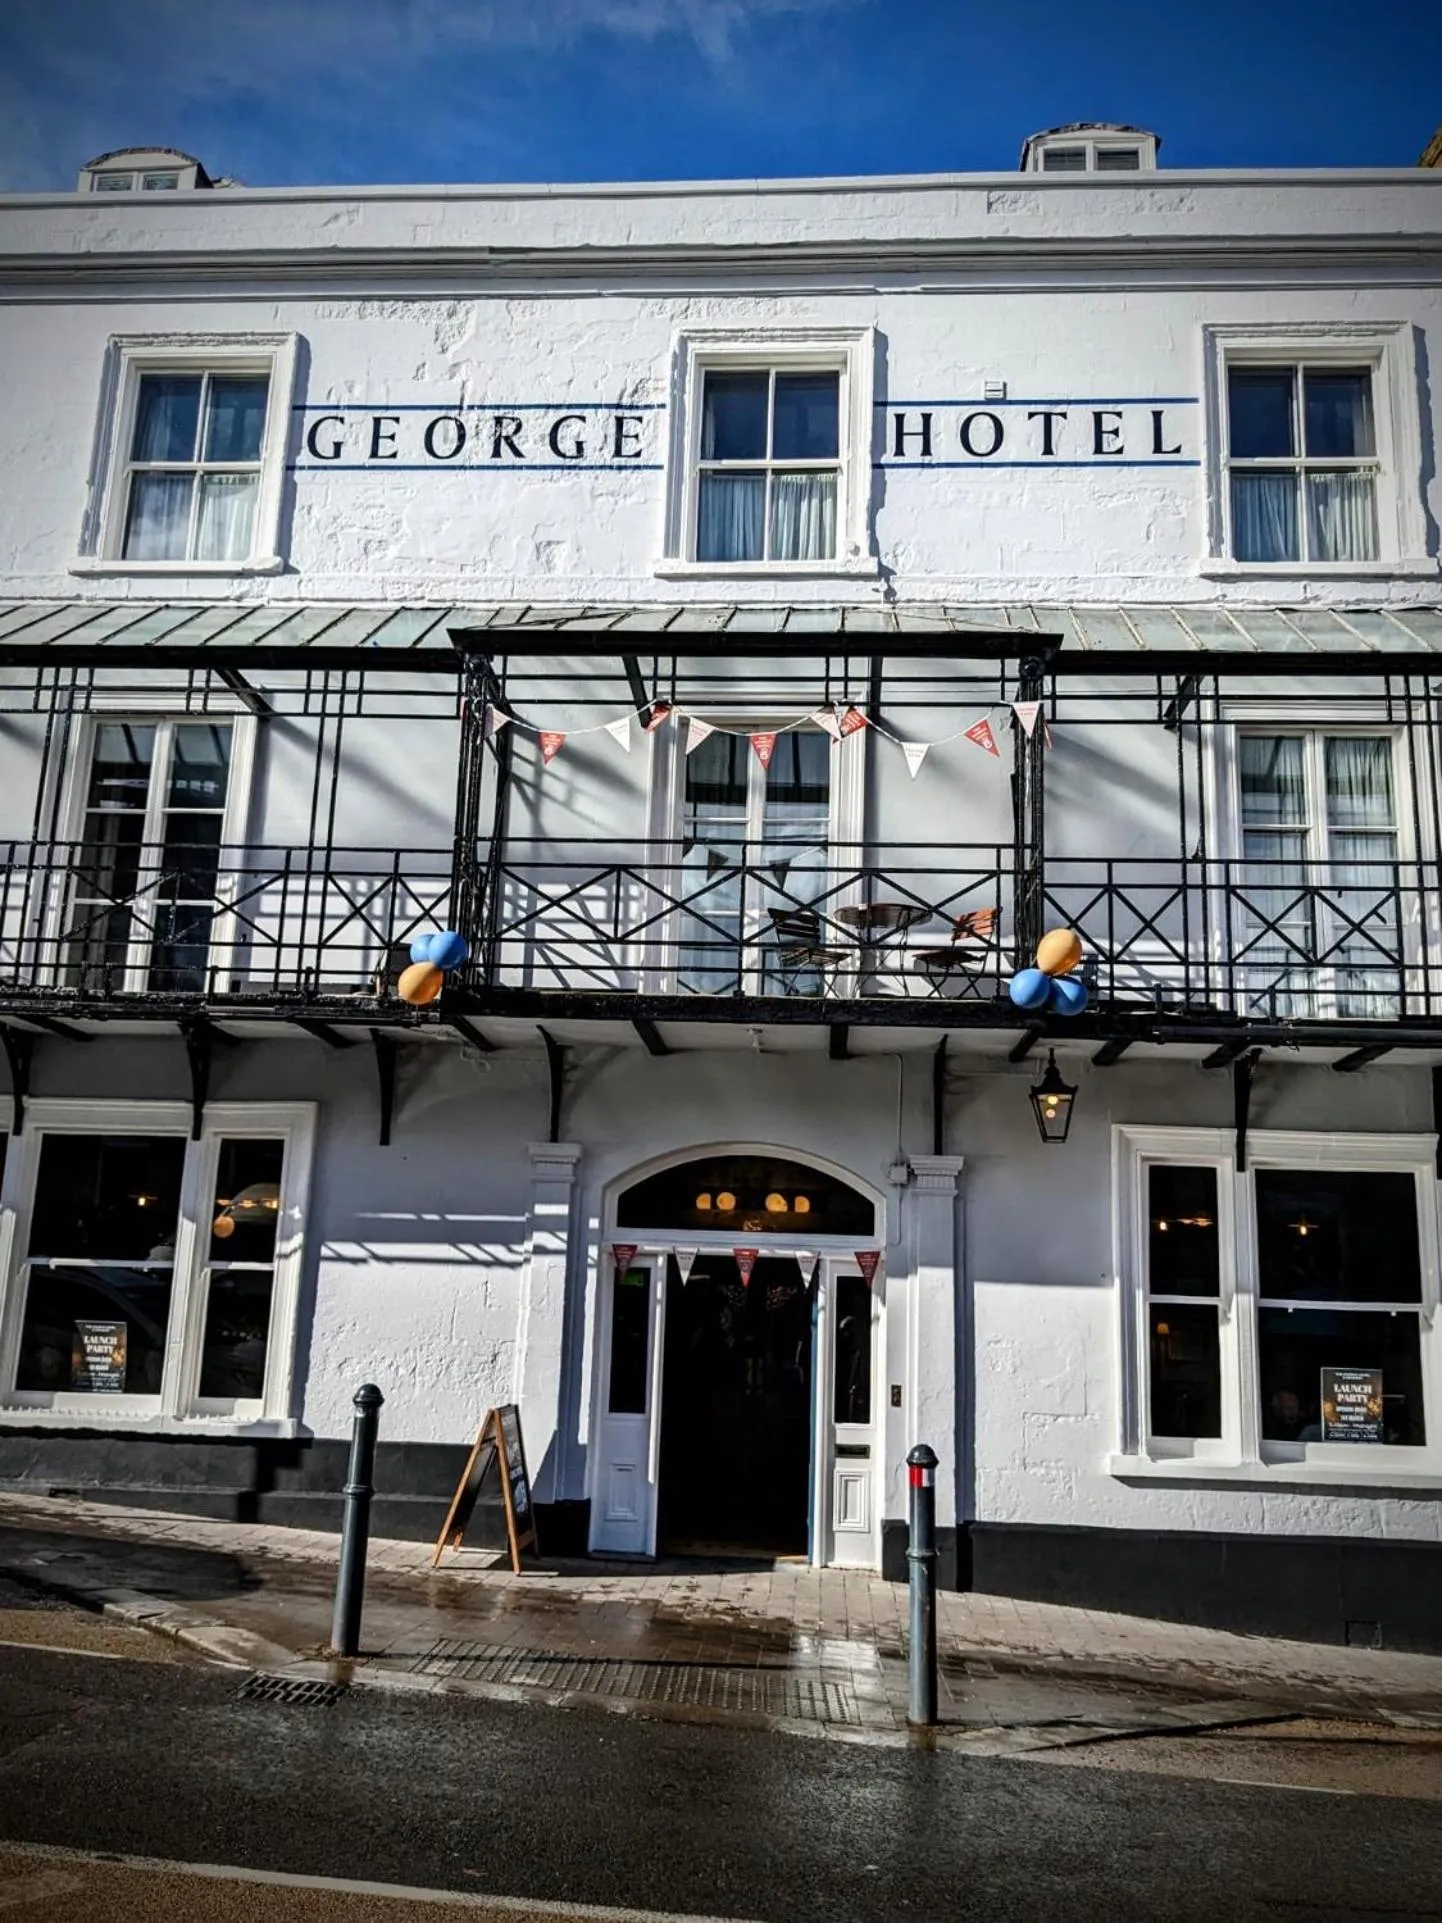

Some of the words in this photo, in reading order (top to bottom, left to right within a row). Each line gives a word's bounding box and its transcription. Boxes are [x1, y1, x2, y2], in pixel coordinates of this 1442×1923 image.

[306, 415, 645, 460] GEORGE
[892, 410, 1183, 457] HOTEL
[83, 1335, 118, 1345] LAUNCH
[86, 1344, 114, 1354] PARTY
[1333, 1383, 1372, 1394] LAUNCH
[1337, 1393, 1368, 1403] PARTY
